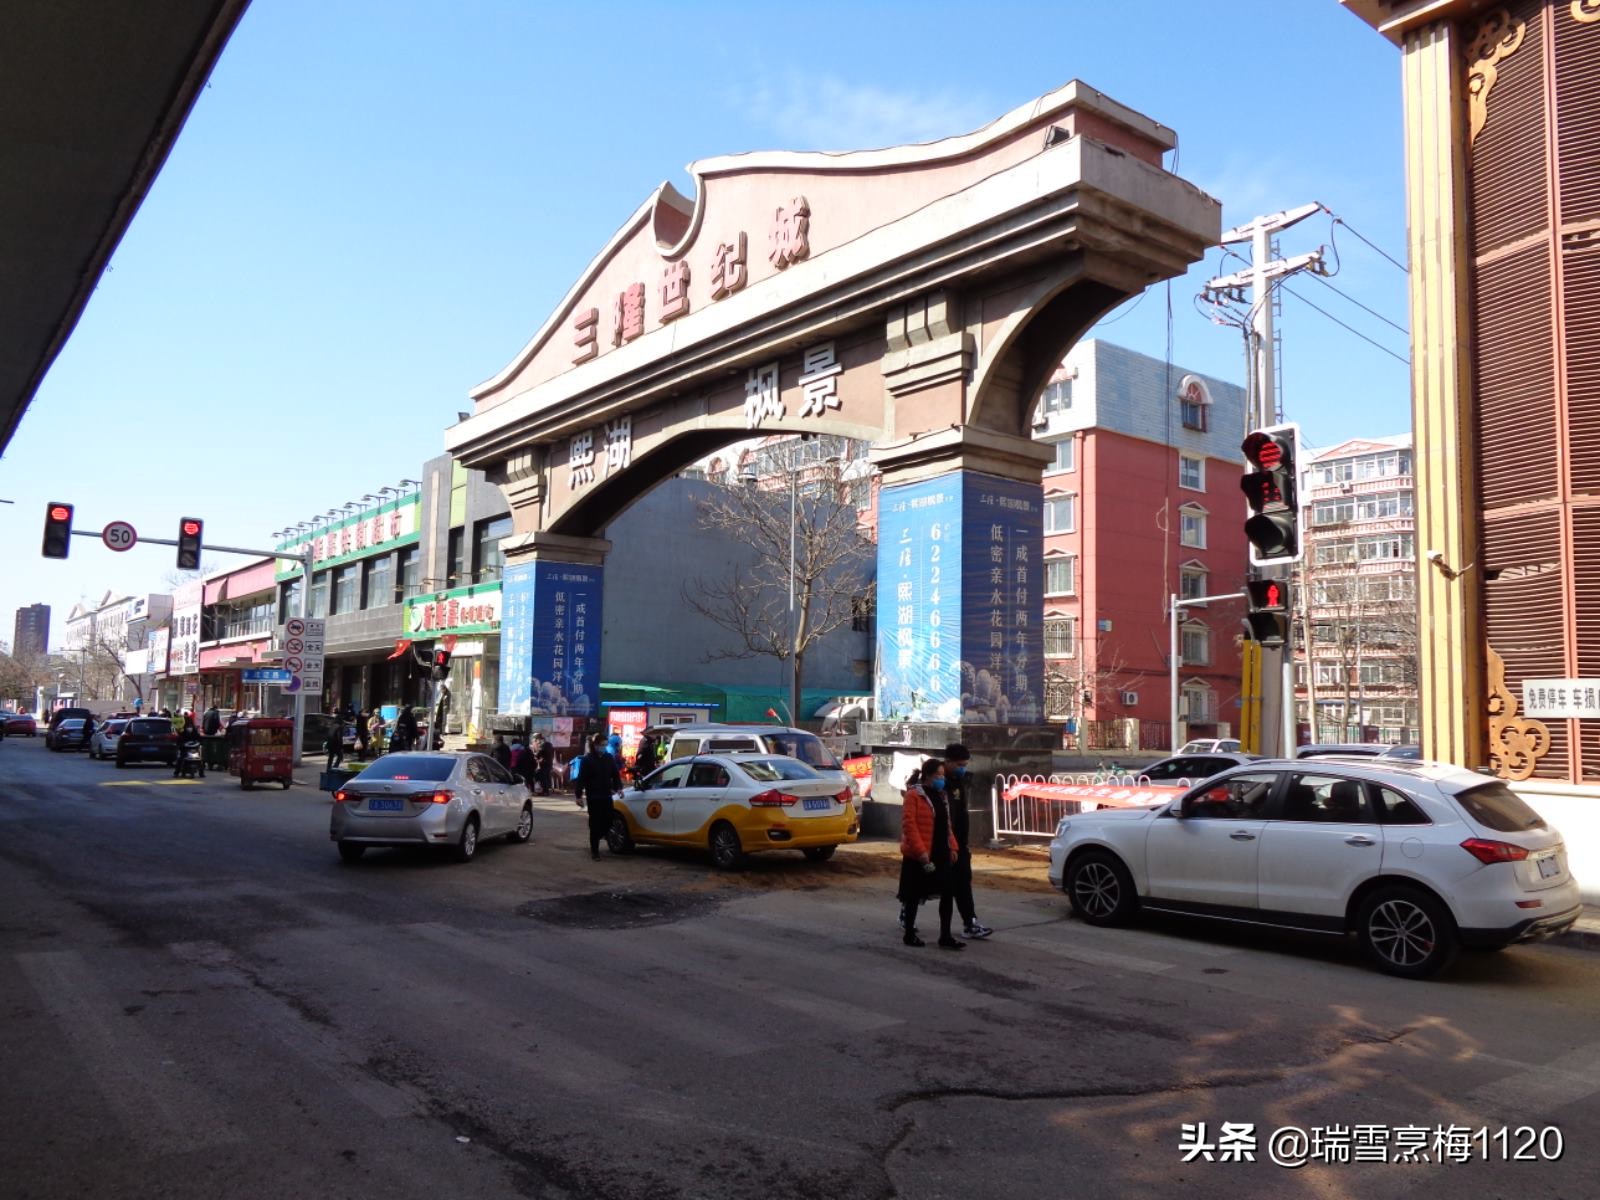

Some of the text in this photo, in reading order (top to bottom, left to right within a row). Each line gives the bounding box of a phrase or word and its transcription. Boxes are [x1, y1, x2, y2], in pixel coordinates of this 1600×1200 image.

[571, 195, 811, 366] 三隆世纪城
[569, 341, 843, 489] 熙湖 枫景
[109, 529, 131, 544] 50
[928, 522, 941, 692] 62246666
[1015, 529, 1029, 692] 一成首付两年分期
[574, 593, 586, 694] 一成首付两年分期
[1528, 687, 1600, 710] 免费停车 车损
